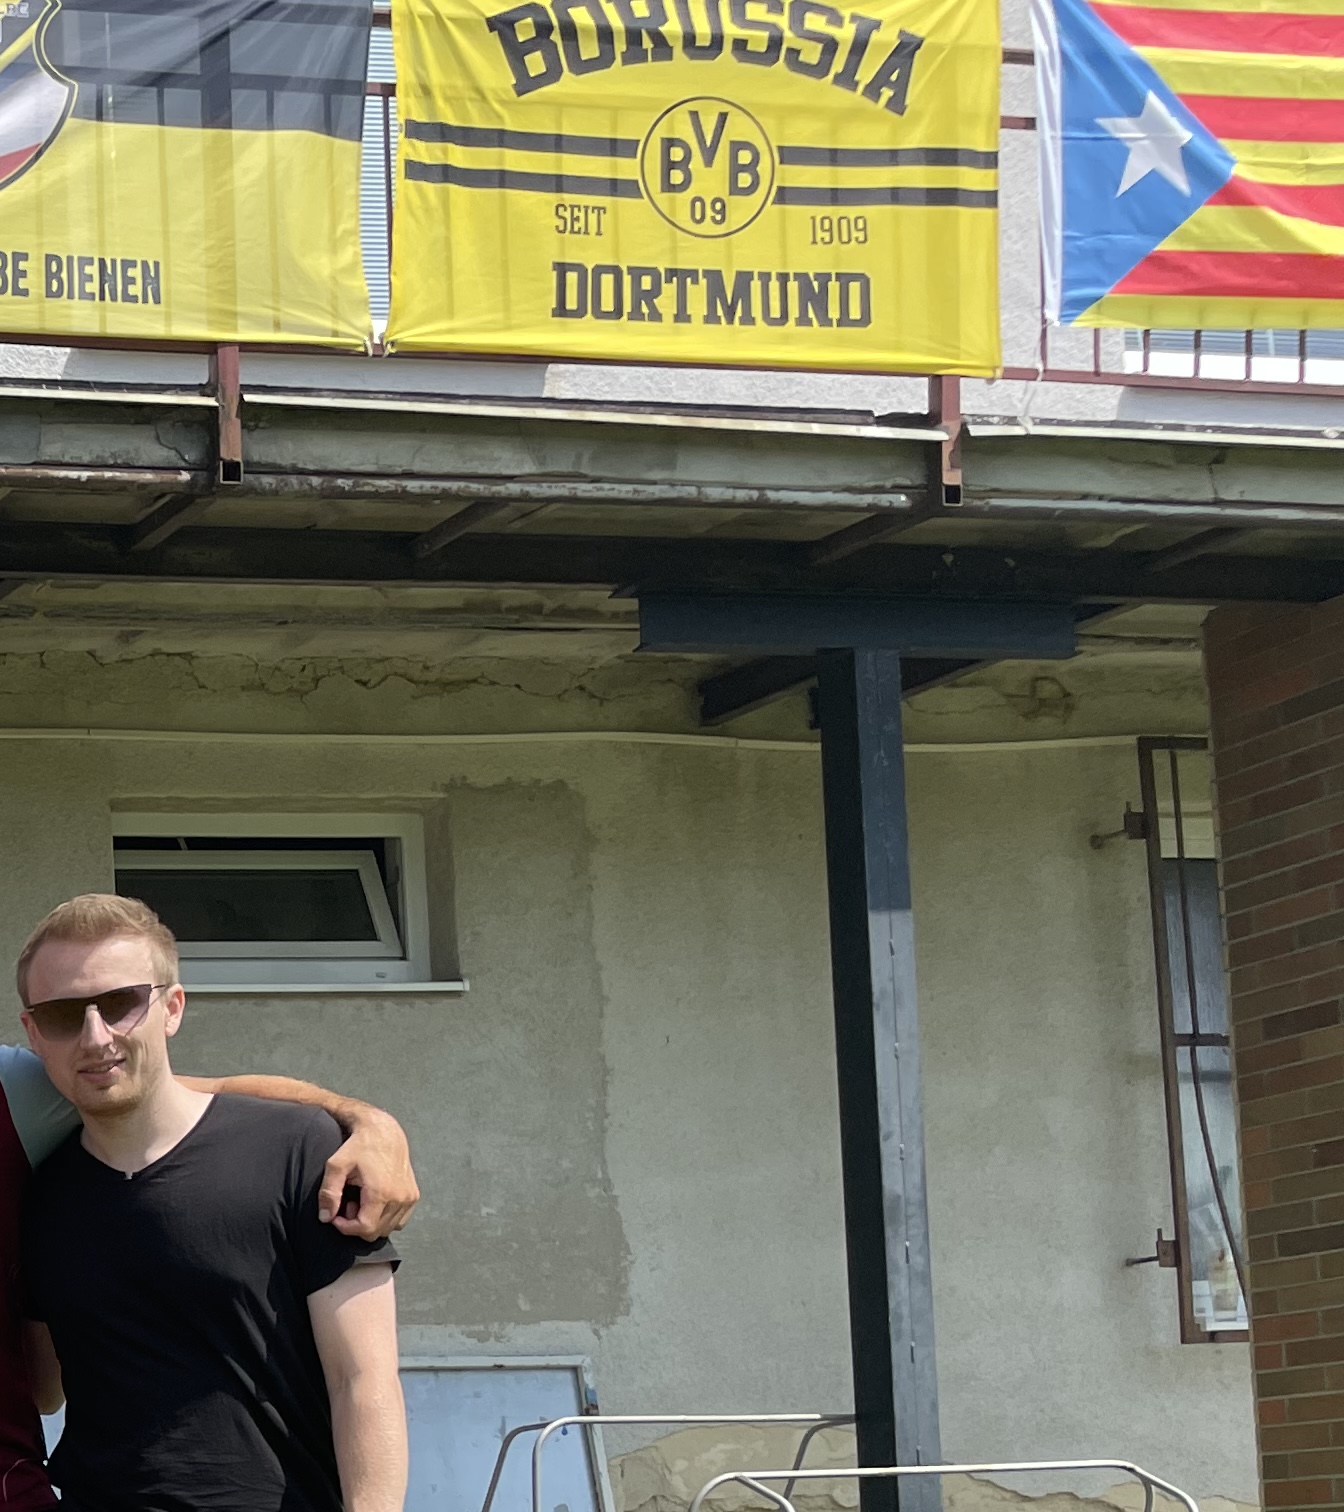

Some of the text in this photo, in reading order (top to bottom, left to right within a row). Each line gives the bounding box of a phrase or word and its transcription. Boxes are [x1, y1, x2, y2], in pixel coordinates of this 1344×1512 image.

[486, 0, 924, 117] BORUSSIA
[660, 110, 761, 197] BVB
[554, 203, 869, 245] SEIT 1909
[690, 196, 726, 225] 09
[43, 253, 162, 304] BIENEN
[551, 261, 872, 328] DORTMUND
